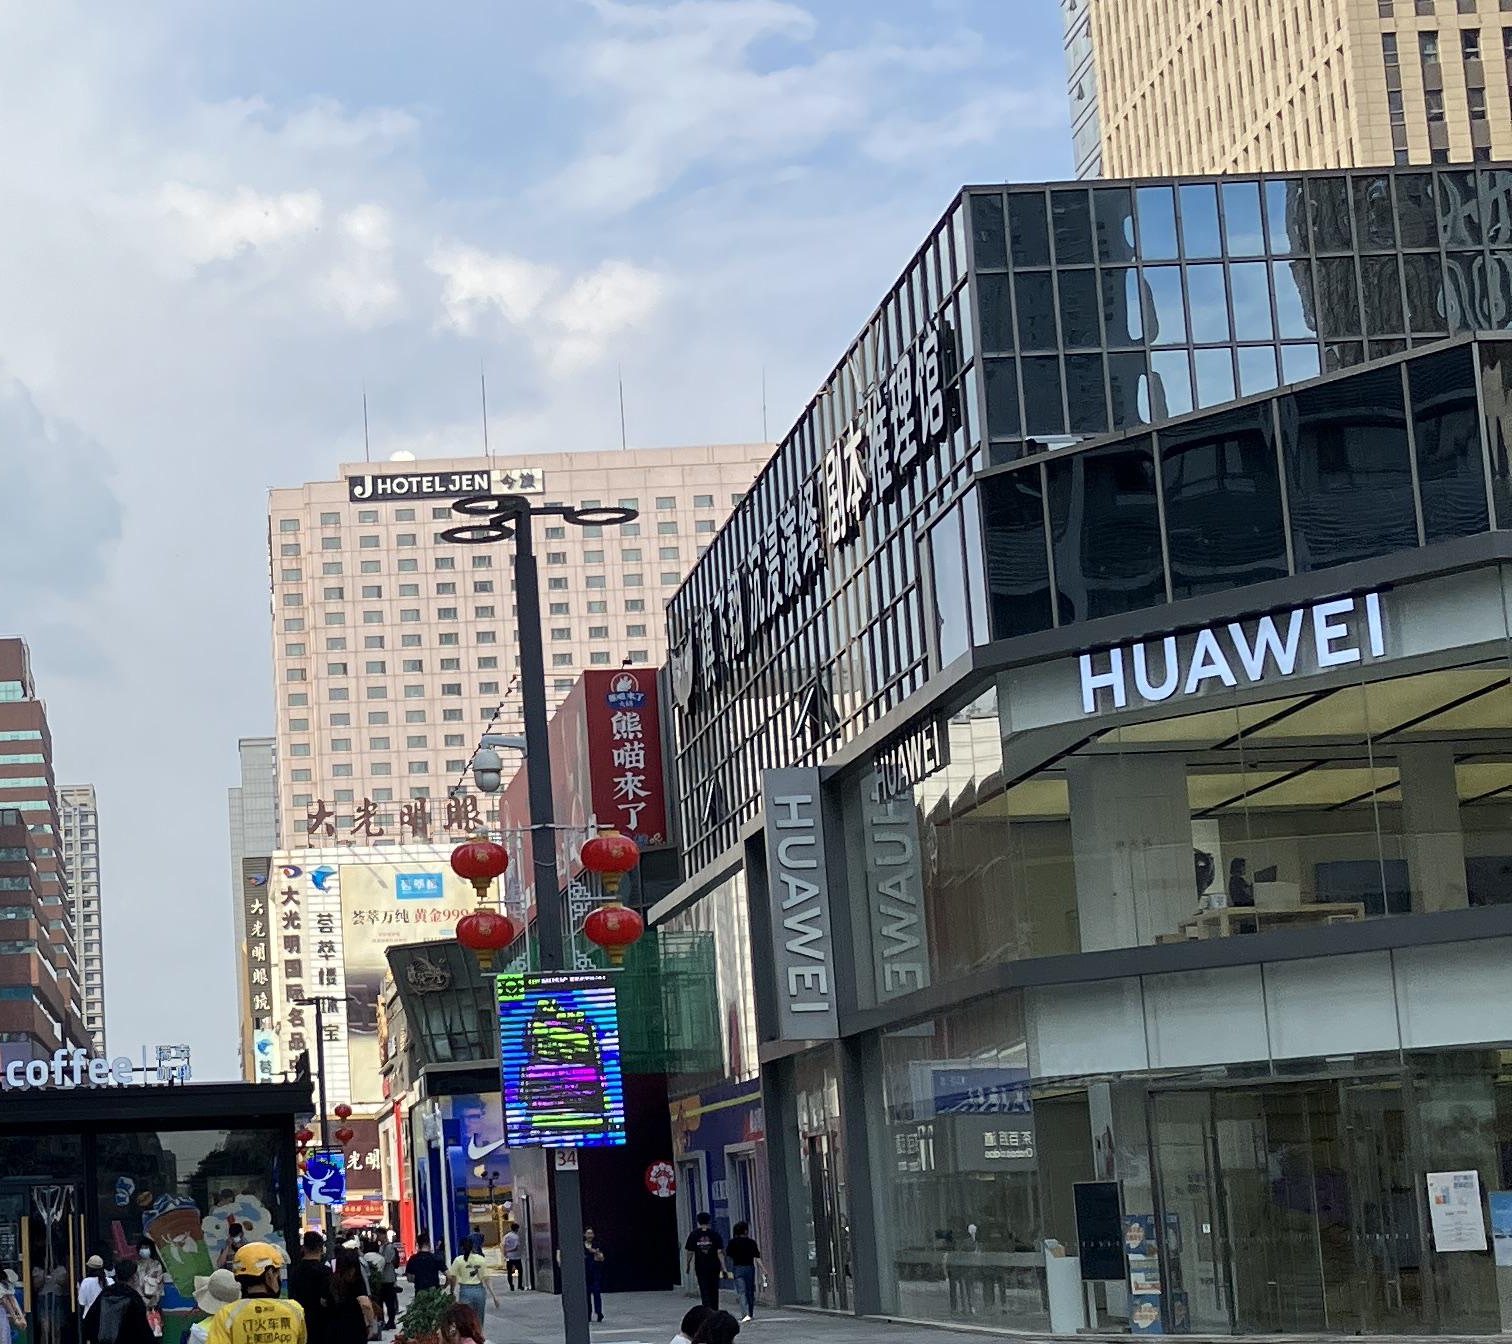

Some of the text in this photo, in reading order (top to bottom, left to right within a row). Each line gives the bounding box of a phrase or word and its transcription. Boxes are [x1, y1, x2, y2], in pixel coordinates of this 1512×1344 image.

[377, 475, 446, 495] HOTEL
[449, 474, 488, 492] JEN
[1079, 592, 1385, 714] HUAWEI
[611, 711, 652, 832] 熊喵來了
[874, 720, 942, 802] HUAWEI
[773, 795, 829, 1012] HUAWEI
[6, 1048, 133, 1086] coffee
[347, 1149, 381, 1171] 光明
[557, 1150, 577, 1167] 34
